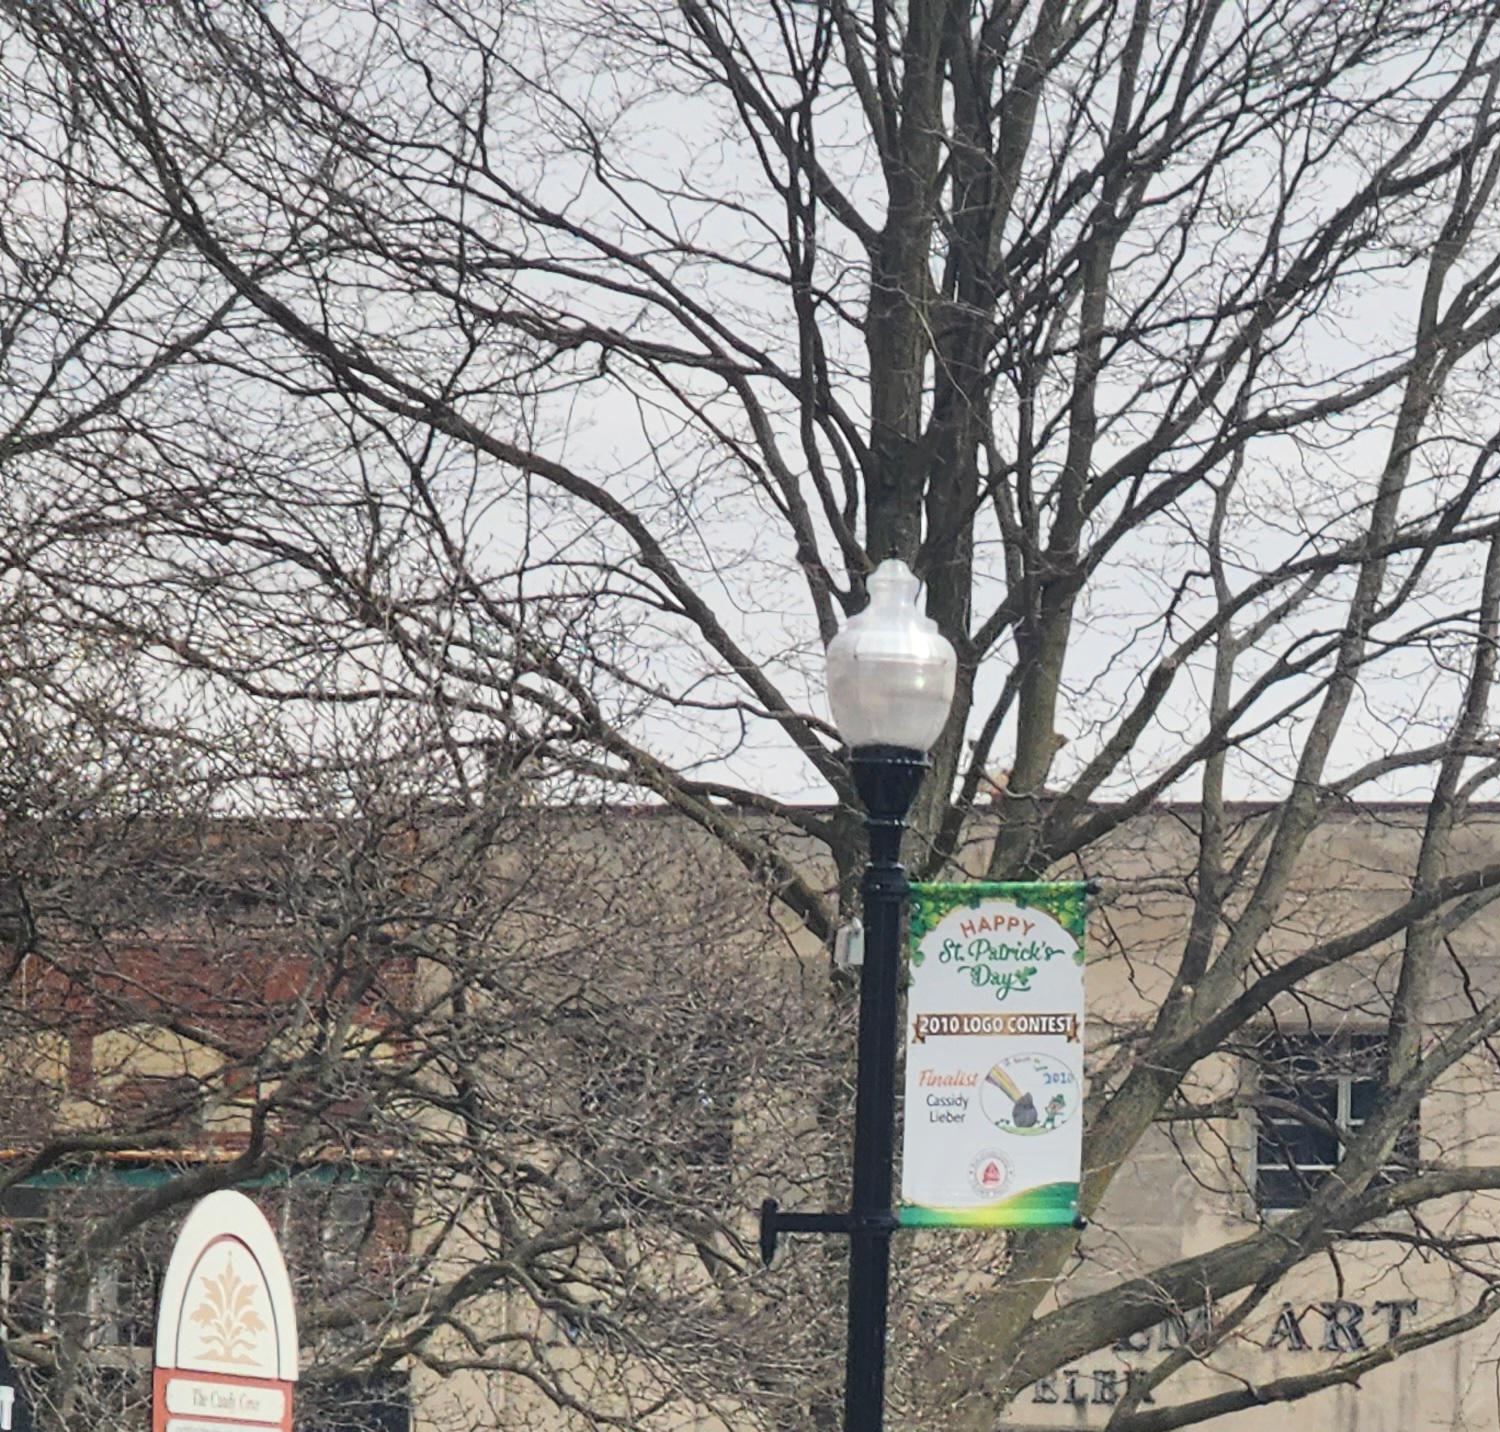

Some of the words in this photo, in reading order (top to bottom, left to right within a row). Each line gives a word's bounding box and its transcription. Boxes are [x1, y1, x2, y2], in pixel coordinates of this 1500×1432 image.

[960, 915, 1036, 938] HAPPY
[939, 939, 965, 963] St.
[968, 938, 1065, 962] Patrick's
[958, 964, 1031, 1000] Day
[920, 1016, 959, 1034] 2010
[963, 1015, 1004, 1034] LOGO
[1007, 1015, 1073, 1033] CONTEST
[918, 1069, 979, 1088] Finalist
[926, 1094, 969, 1110] Cassidy
[929, 1110, 966, 1124] Lieber
[1262, 1300, 1418, 1353] ART
